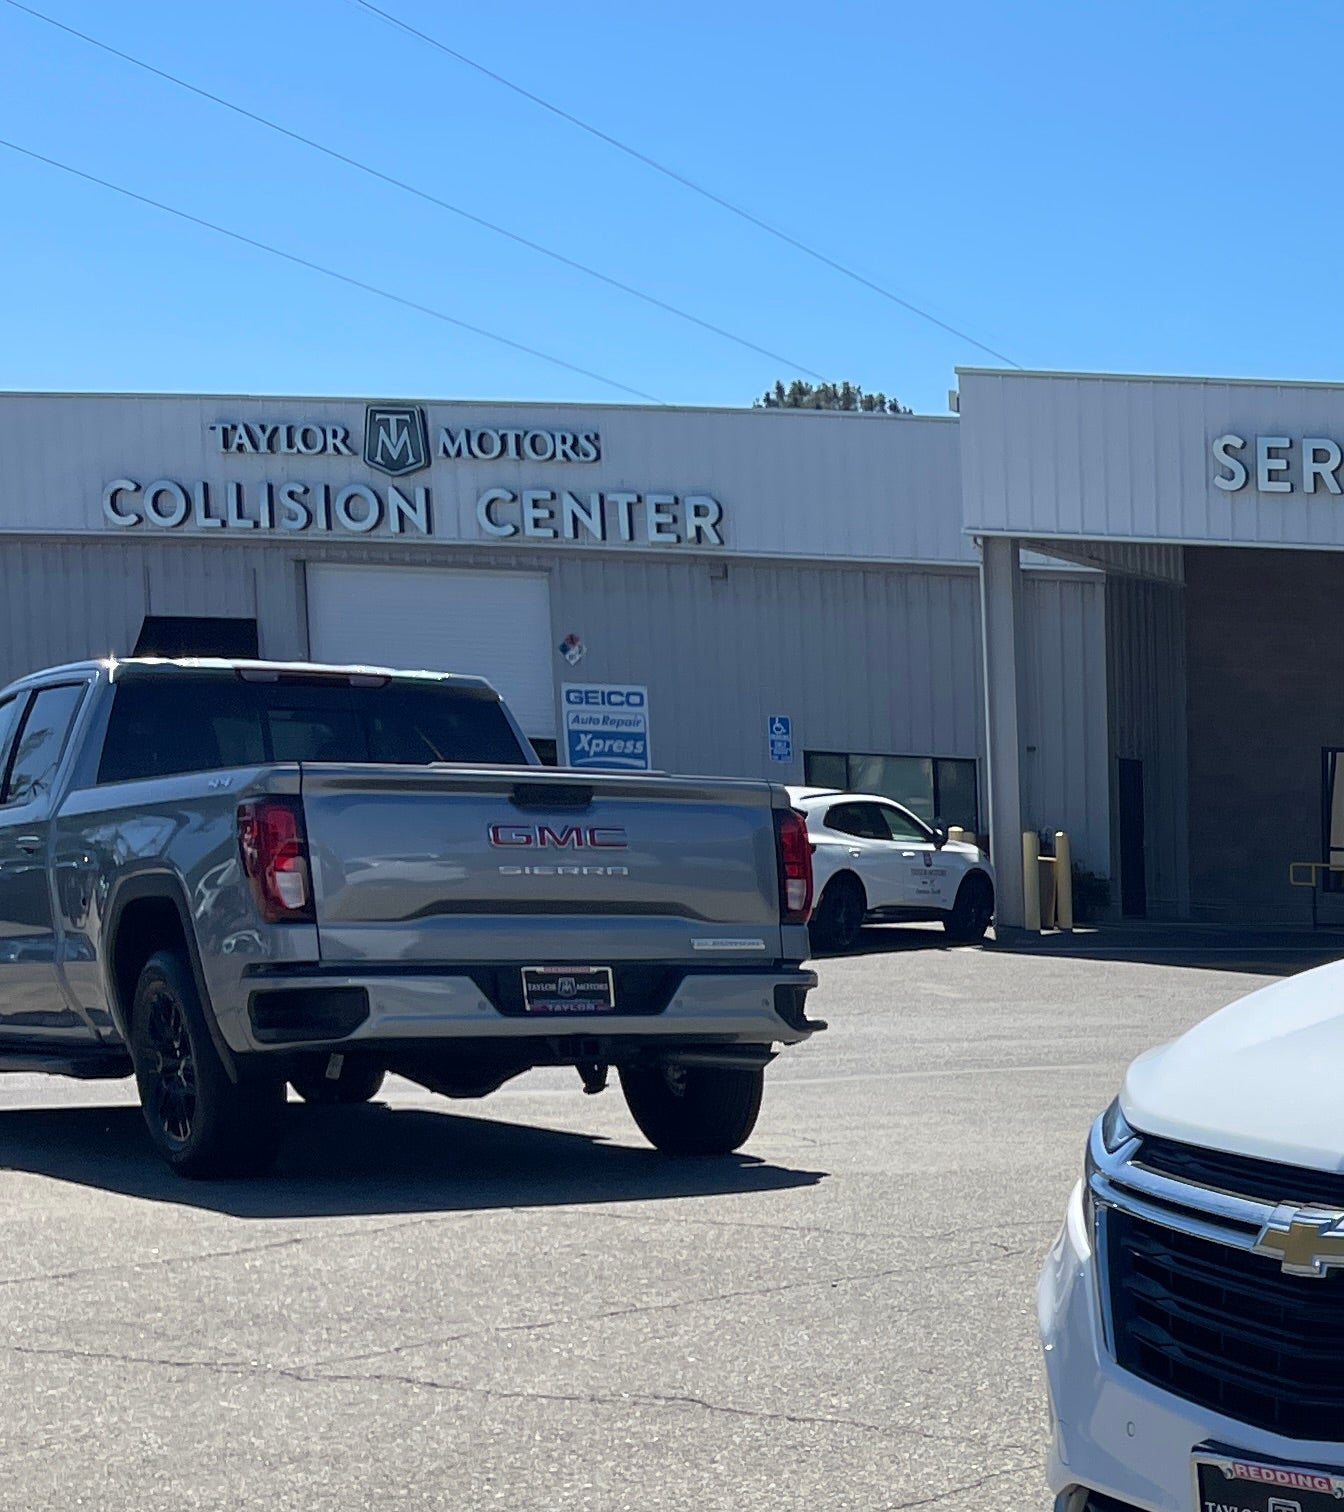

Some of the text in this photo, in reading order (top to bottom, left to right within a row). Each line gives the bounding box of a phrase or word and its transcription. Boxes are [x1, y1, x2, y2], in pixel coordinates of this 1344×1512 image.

[210, 422, 355, 456] TAYLOR
[437, 428, 600, 462] MOTORS
[102, 478, 724, 545] COLLISION CENTER
[565, 688, 645, 707] GEICO
[571, 714, 643, 729] Auto Repair
[575, 733, 645, 756] Xpress
[488, 824, 630, 849] GMC
[498, 865, 629, 876] SIERRA
[1233, 1463, 1330, 1491] REDDING
